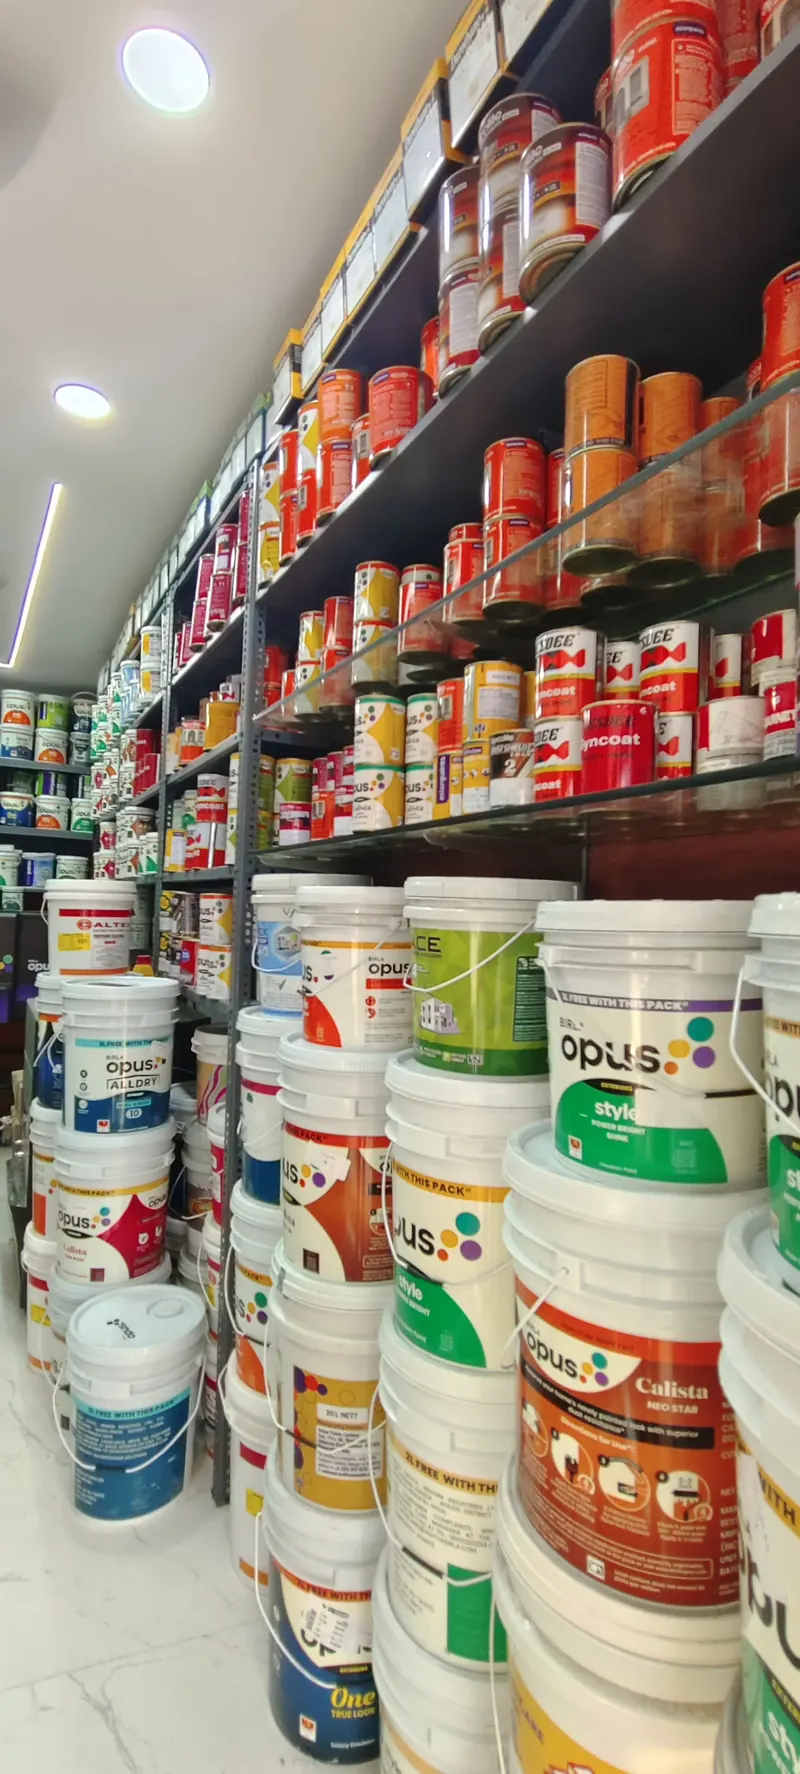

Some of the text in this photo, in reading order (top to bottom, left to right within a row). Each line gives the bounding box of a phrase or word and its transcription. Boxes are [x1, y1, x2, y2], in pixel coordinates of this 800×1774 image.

[589, 997, 617, 1008] WITH
[647, 1001, 683, 1011] PACK
[562, 1034, 661, 1074] opus
[106, 1060, 153, 1075] opus
[110, 1077, 157, 1090] ALLDRY
[130, 1109, 139, 1118] 10
[411, 1175, 430, 1188] THIS
[432, 1181, 465, 1197] PACK
[58, 1210, 90, 1229] opus
[527, 1332, 578, 1378] opus
[635, 1376, 709, 1399] Calista
[95, 1409, 112, 1418] FREE
[137, 1407, 154, 1416] THIS
[154, 1400, 175, 1412] PACK
[647, 1401, 699, 1415] NEO STAR
[648, 1425, 665, 1436] with
[666, 1430, 699, 1439] superior
[415, 1459, 440, 1481] FREE
[443, 1474, 476, 1491] WITH
[331, 1686, 376, 1708] One
[331, 1706, 376, 1719] TRUE LOOK
